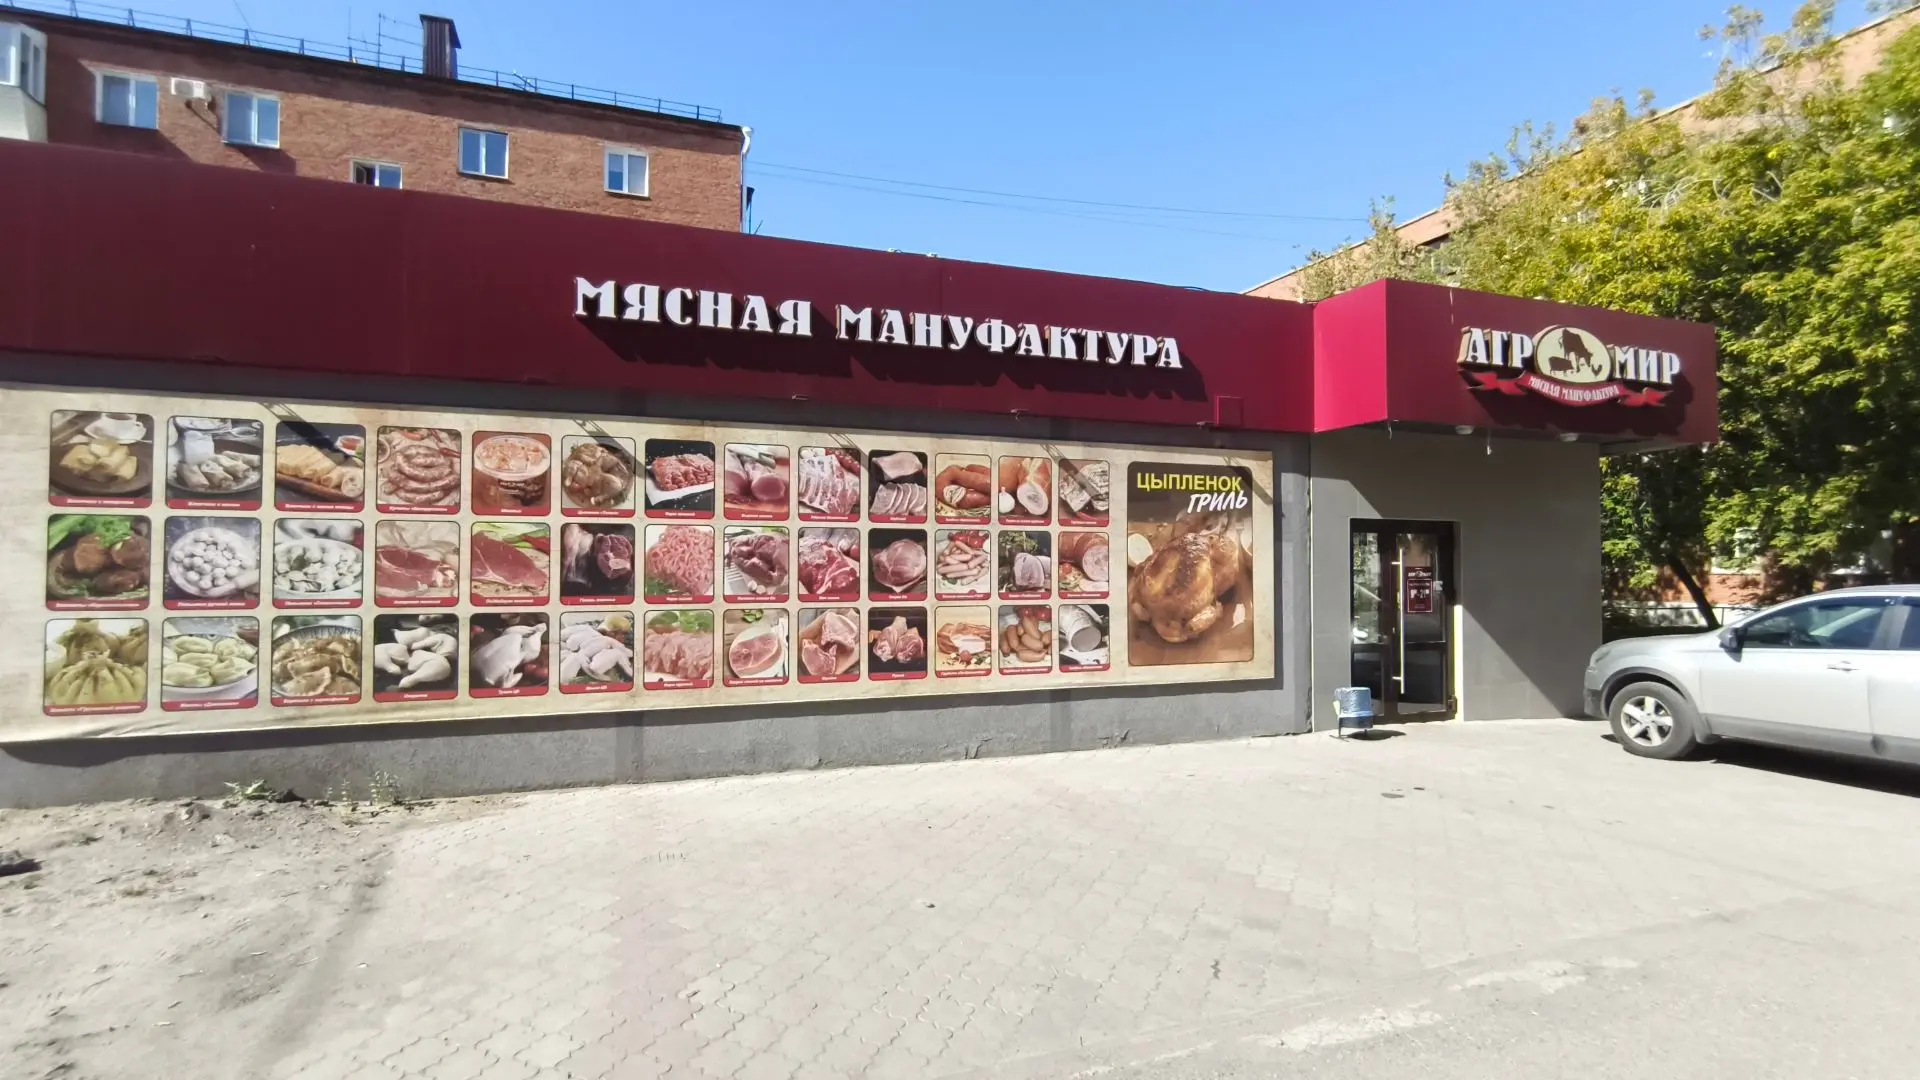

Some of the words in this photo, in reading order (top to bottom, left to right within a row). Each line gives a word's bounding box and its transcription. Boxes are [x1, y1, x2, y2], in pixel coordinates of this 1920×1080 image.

[574, 276, 812, 337] МЯСНАЯ
[834, 303, 1184, 370] МАНУФАКТУРА
[1528, 375, 1560, 398] МЯСНАЯ
[1562, 385, 1619, 402] МАНУФАКТУРА
[1136, 472, 1242, 492] ЦЫПЛЕНОК
[1187, 490, 1249, 513] ГРИЛЬ
